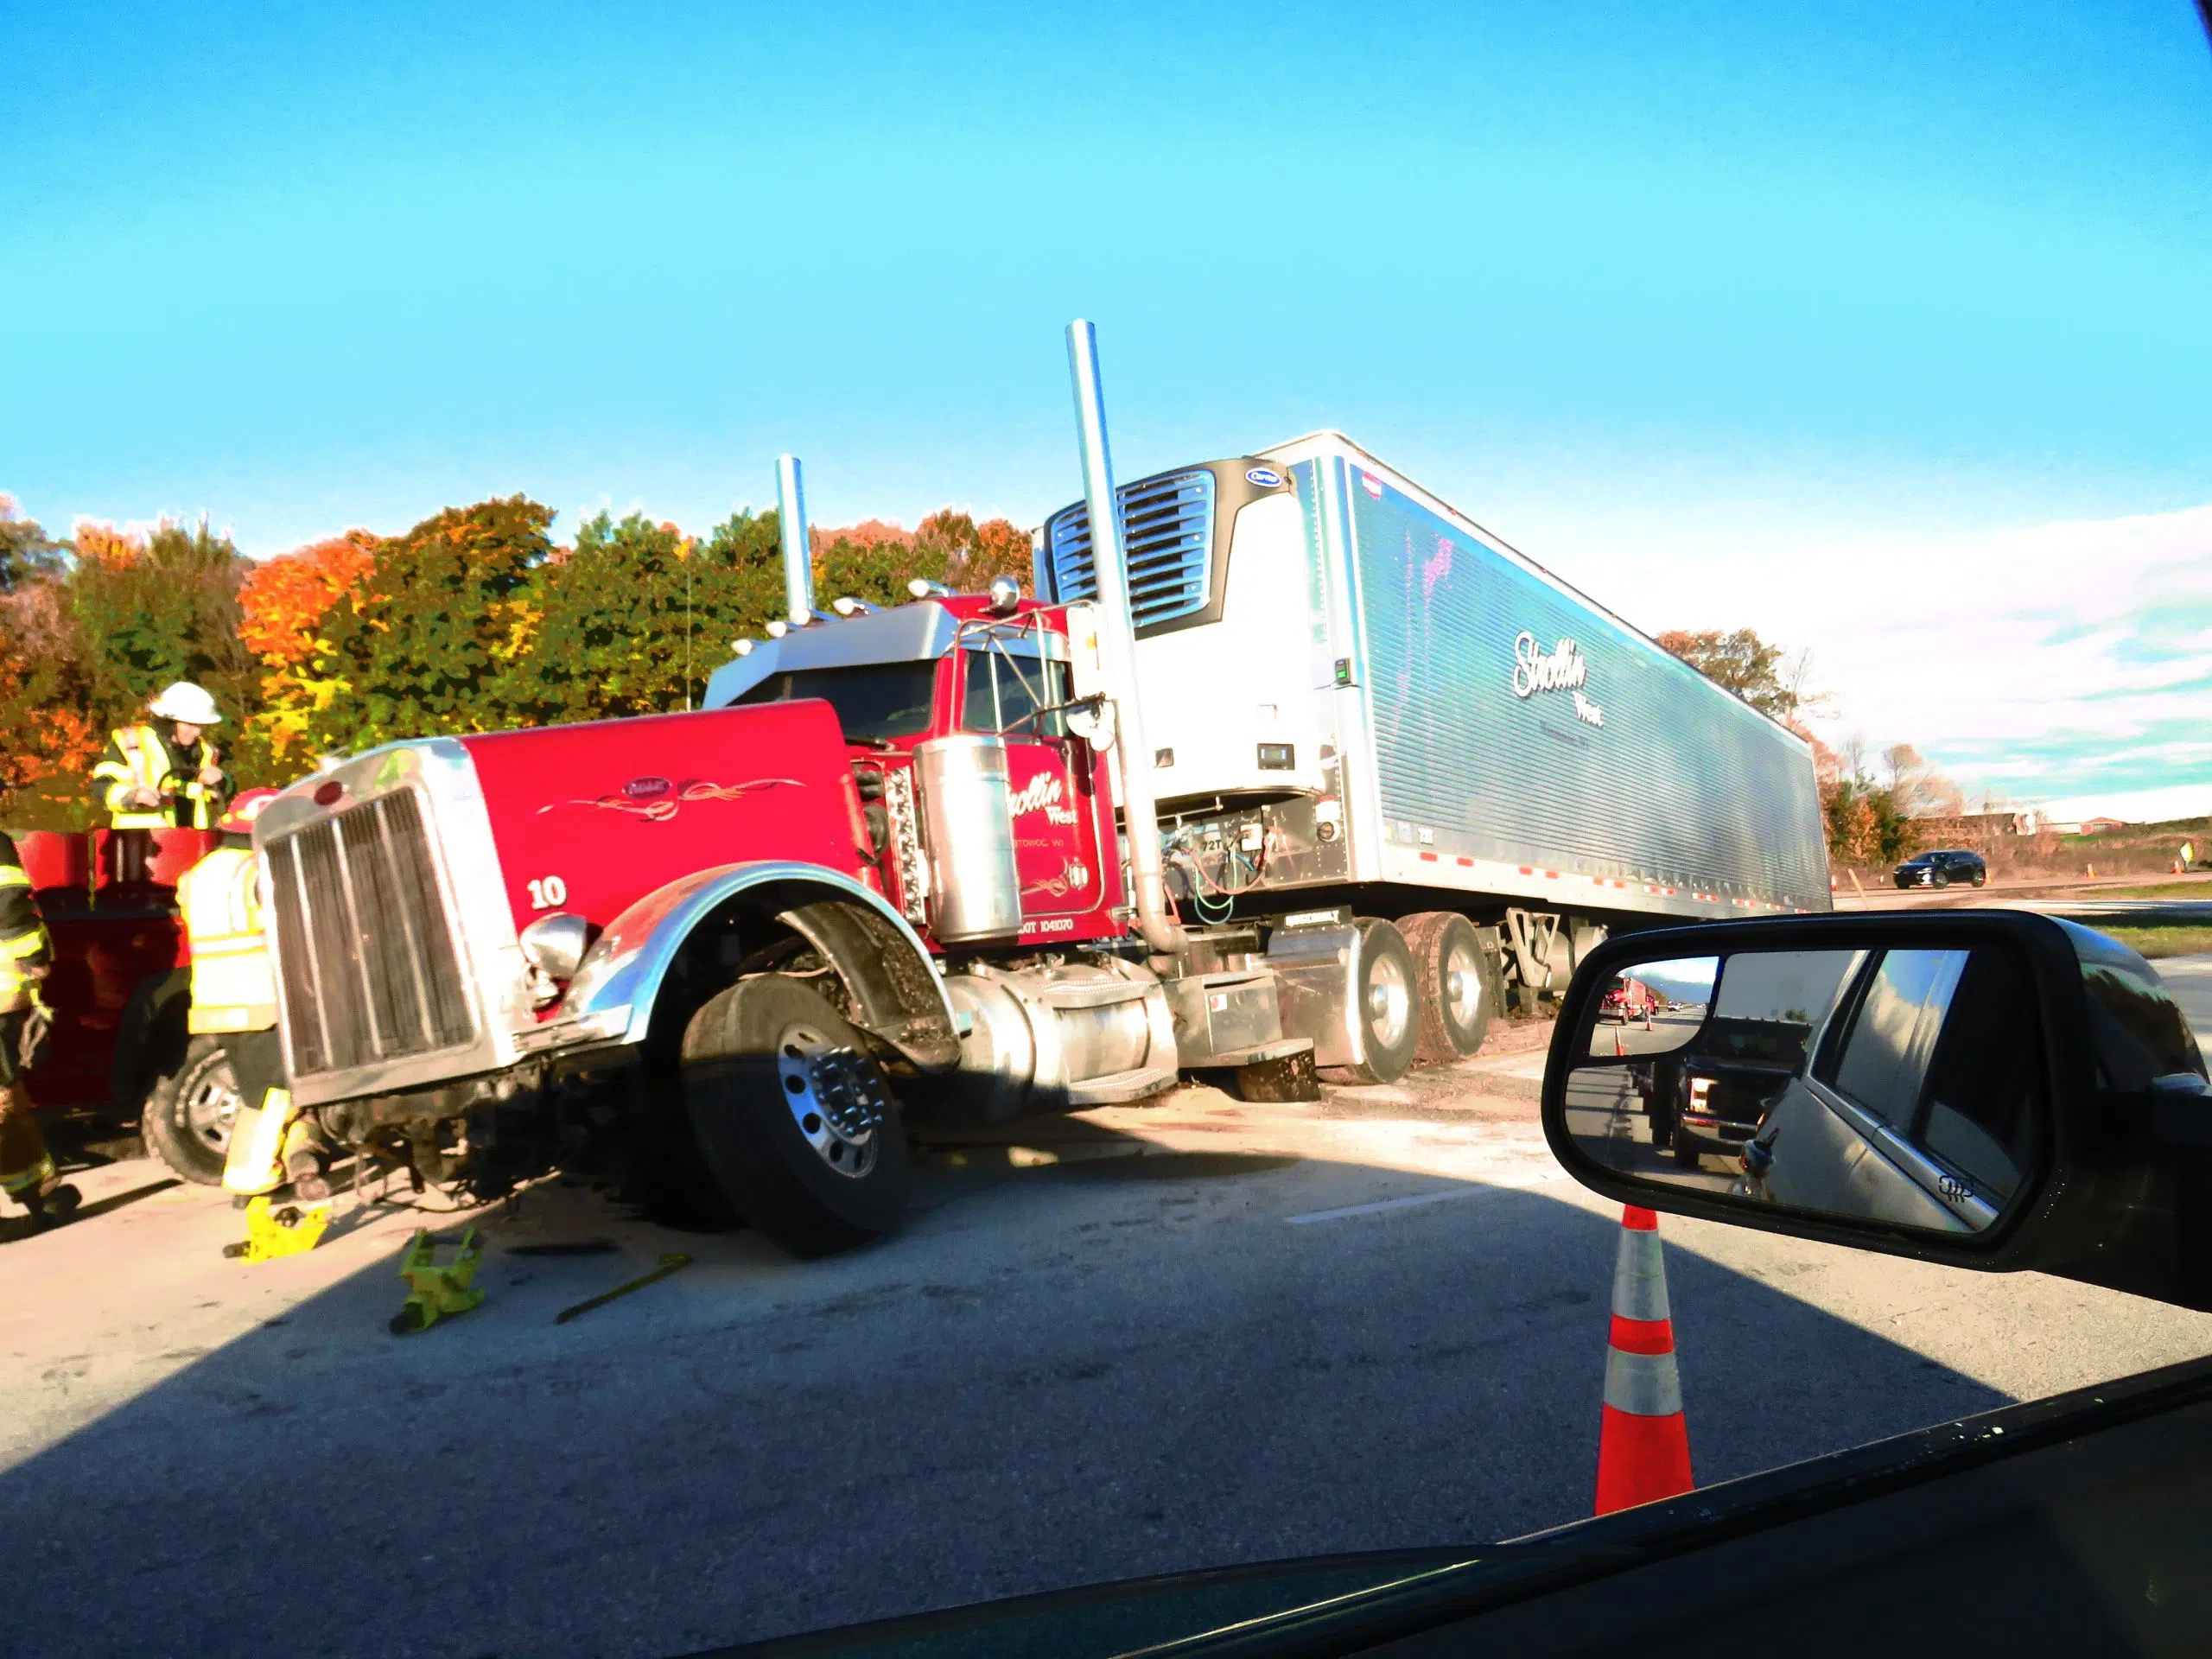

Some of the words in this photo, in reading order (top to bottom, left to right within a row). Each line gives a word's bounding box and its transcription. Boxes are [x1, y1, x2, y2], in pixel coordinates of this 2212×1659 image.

[1514, 631, 1586, 698] Strollin
[1045, 806, 1078, 826] West
[1202, 840, 1221, 851] 72T
[526, 875, 568, 911] 10
[1040, 918, 1073, 932] 1041070
